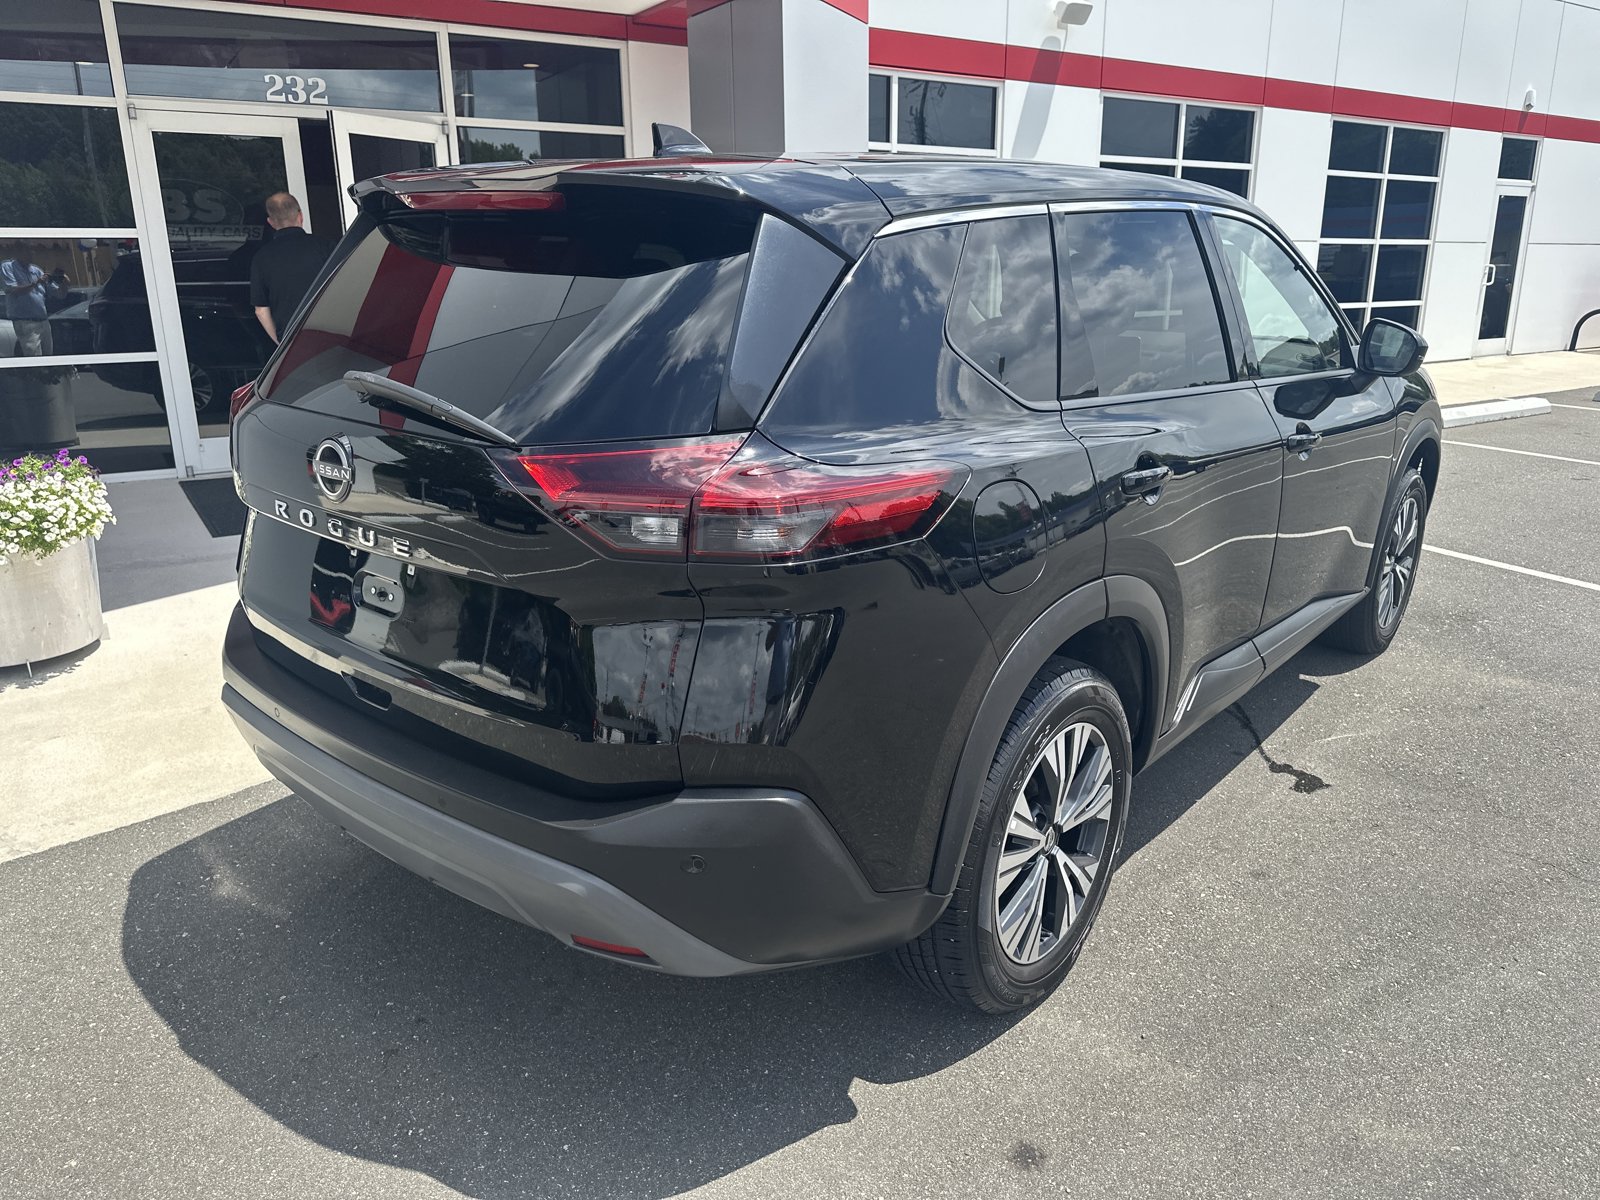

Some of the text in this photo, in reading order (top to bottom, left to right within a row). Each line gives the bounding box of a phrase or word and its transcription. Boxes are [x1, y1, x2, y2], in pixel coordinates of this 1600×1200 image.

[264, 74, 329, 105] 232
[223, 226, 261, 239] CARS
[275, 500, 412, 558] ROGUE
